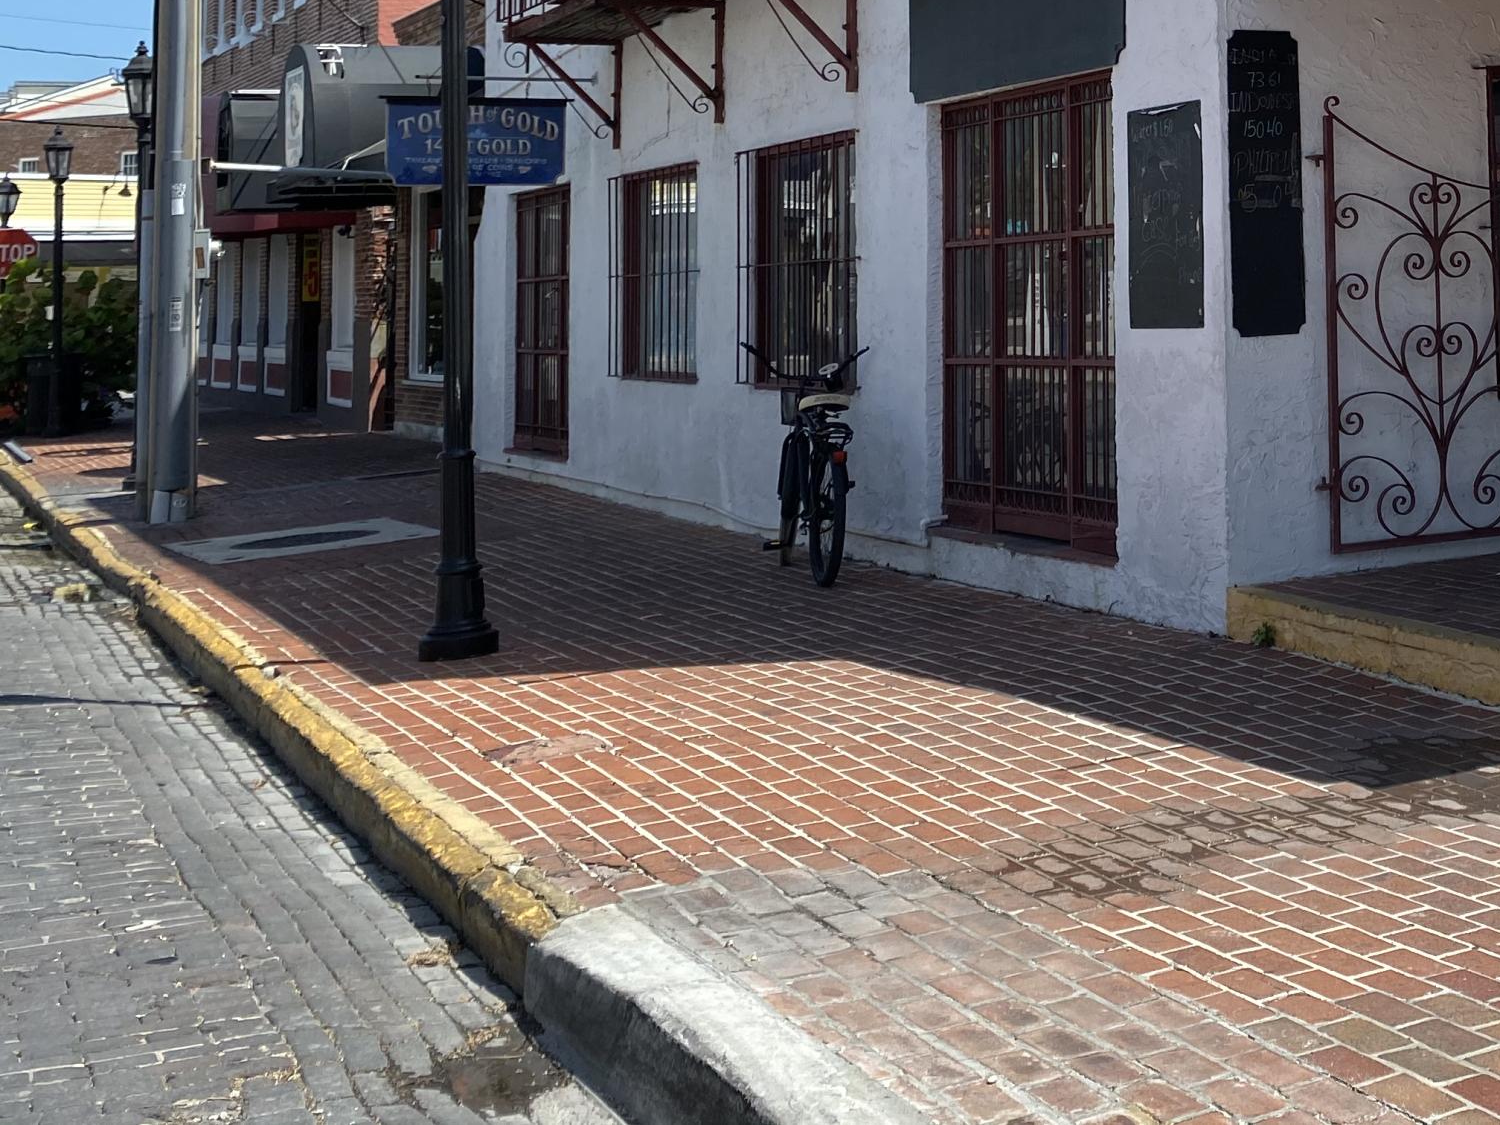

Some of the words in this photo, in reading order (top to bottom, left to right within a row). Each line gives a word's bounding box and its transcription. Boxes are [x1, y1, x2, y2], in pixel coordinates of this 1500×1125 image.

[397, 105, 486, 140] TOUH
[500, 107, 559, 141] GOLD
[477, 139, 532, 156] GOLD
[0, 244, 36, 263] TOP
